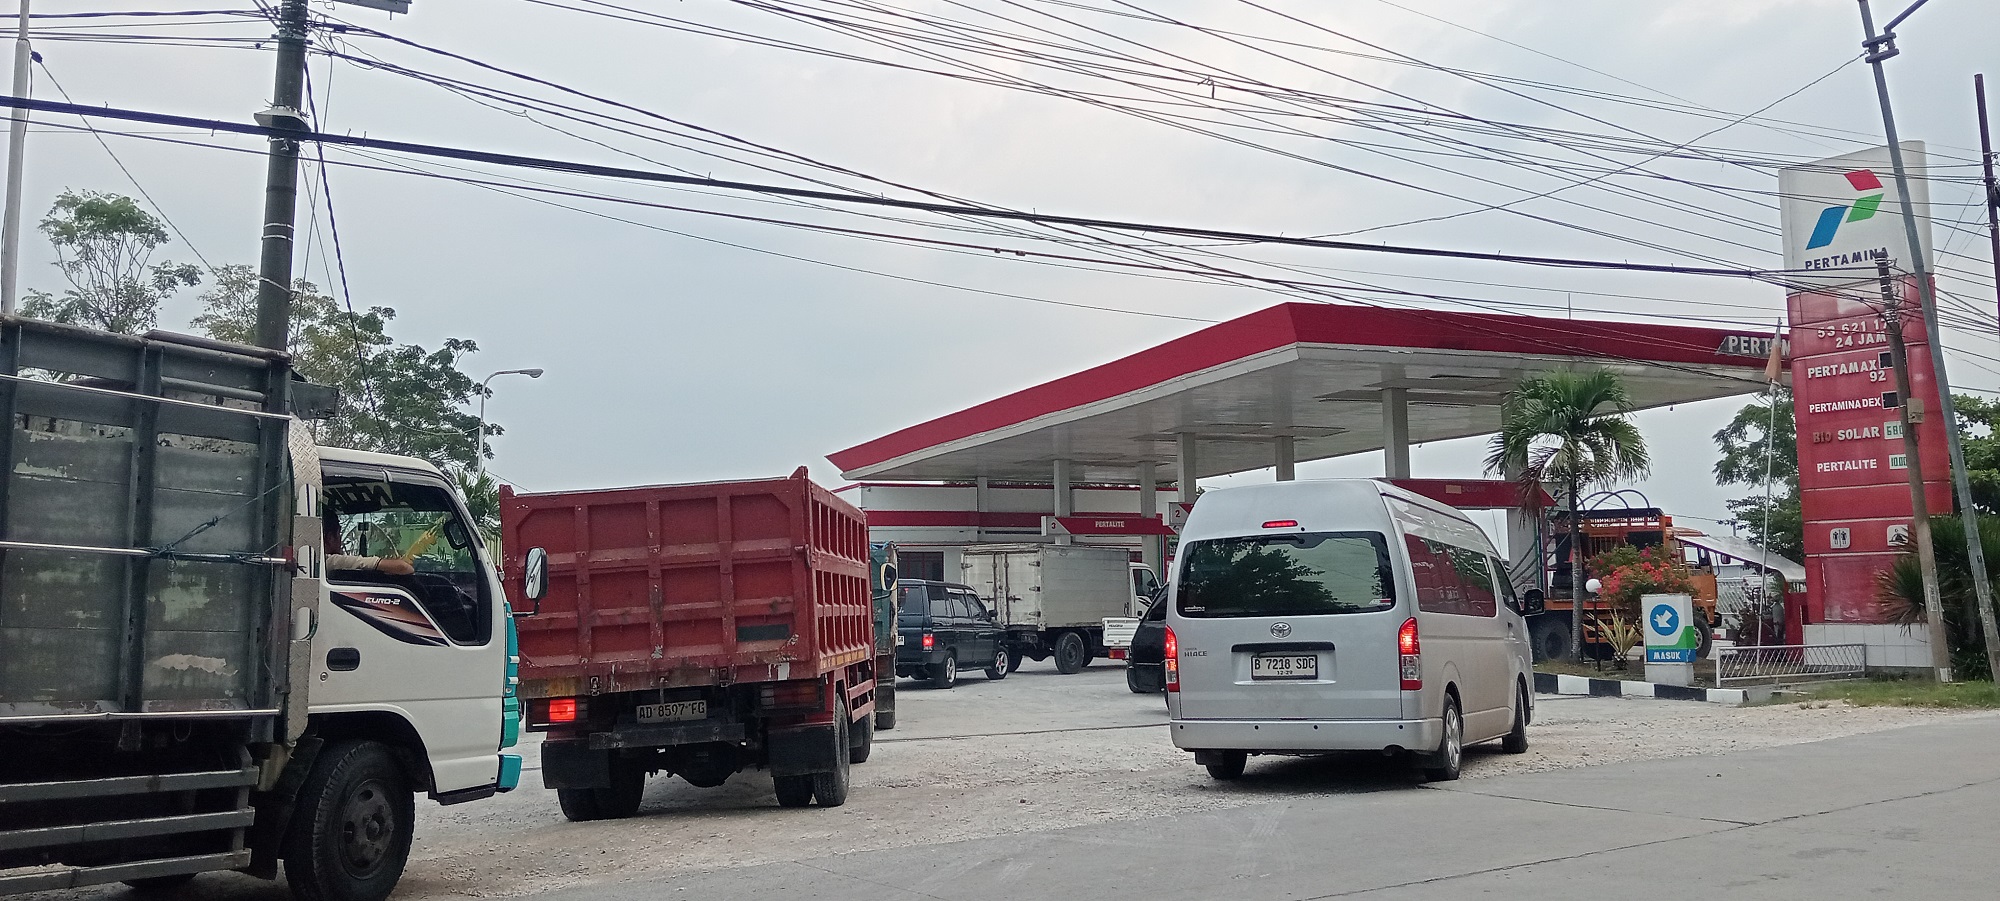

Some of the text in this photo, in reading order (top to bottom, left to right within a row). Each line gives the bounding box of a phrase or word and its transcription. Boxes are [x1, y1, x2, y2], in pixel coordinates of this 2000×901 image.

[1805, 247, 1889, 270] PERTAMINA
[1842, 321, 1866, 334] 621
[1836, 331, 1887, 348] 24 JAM
[1807, 360, 1877, 379] PERTAMAX
[1869, 371, 1887, 382] 92
[1809, 397, 1881, 413] PERTAMINA DEX
[1813, 426, 1880, 443] BIO SOLAR
[1817, 459, 1877, 473] PERTALITE
[1175, 510, 1180, 518] 2
[1051, 522, 1057, 530] 3
[365, 597, 401, 605] EURO-2
[1653, 651, 1681, 660] MASUK
[1254, 658, 1315, 670] B 7218 SDC
[640, 701, 705, 719] AD 8597 FG
